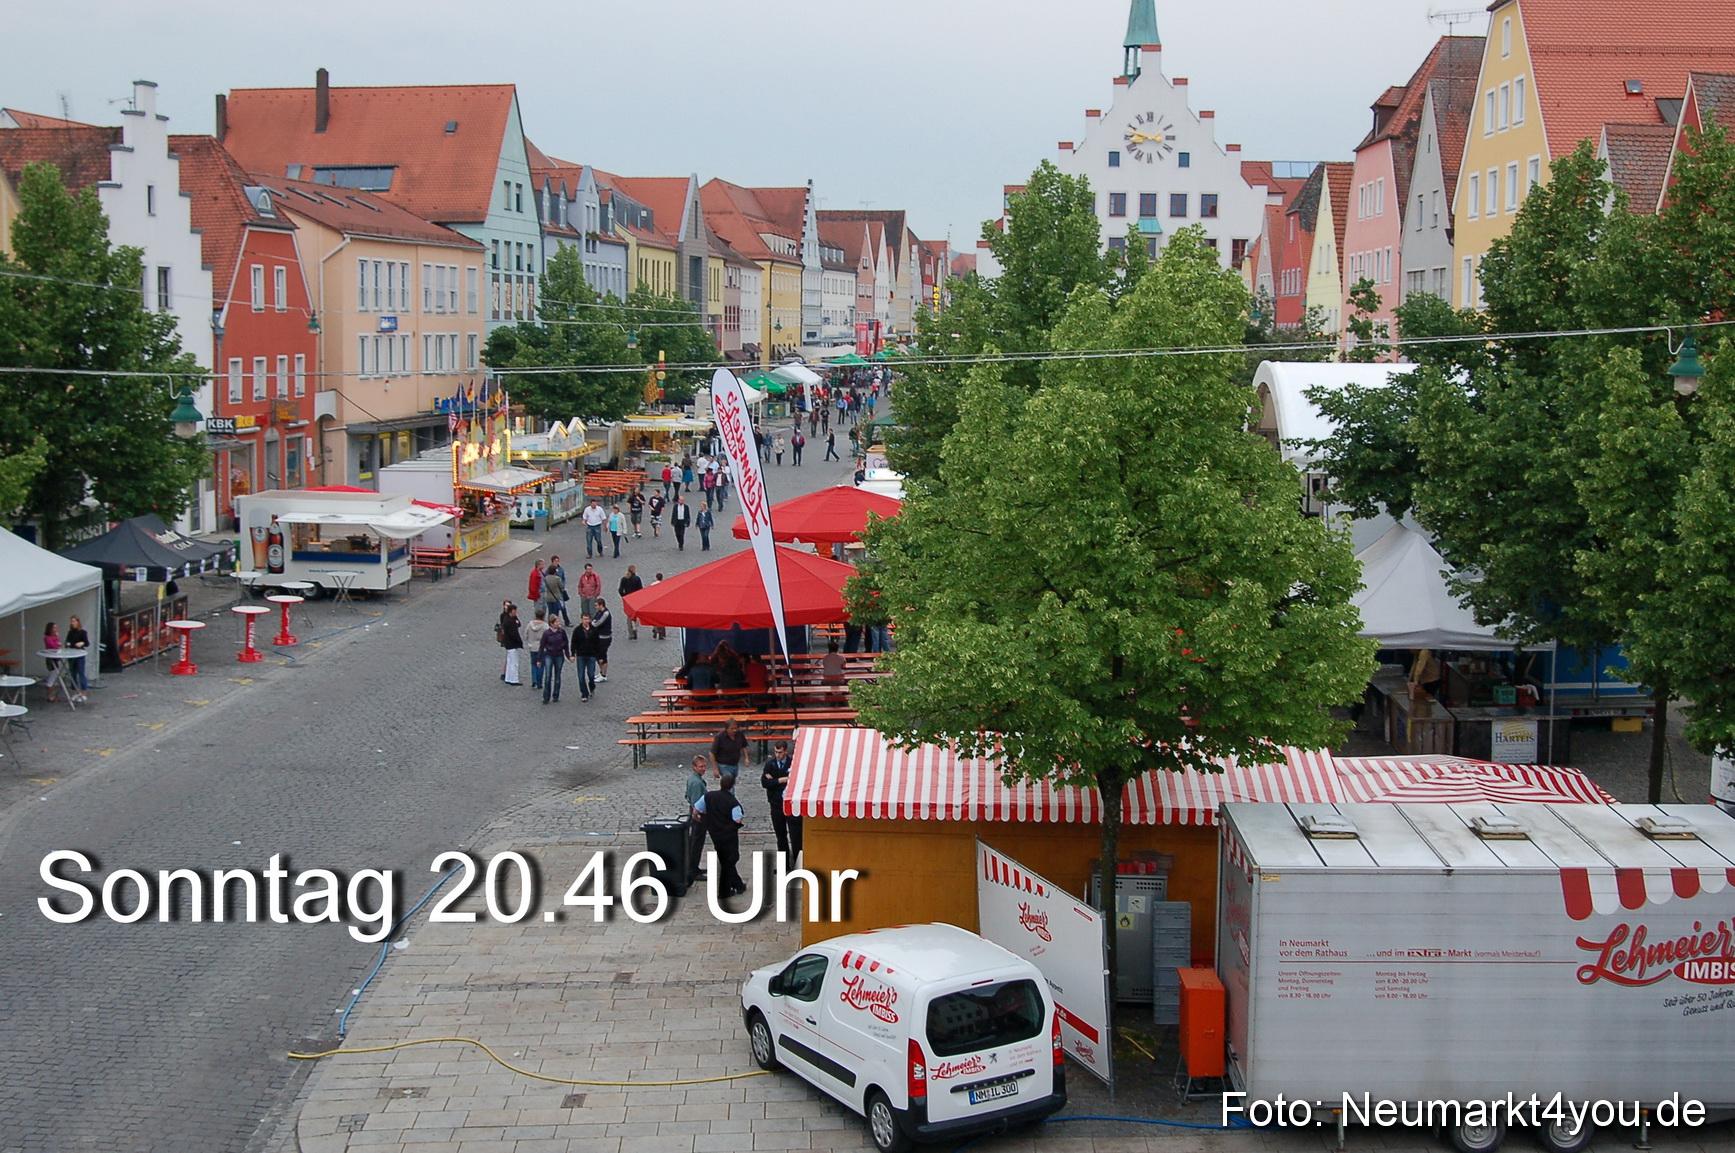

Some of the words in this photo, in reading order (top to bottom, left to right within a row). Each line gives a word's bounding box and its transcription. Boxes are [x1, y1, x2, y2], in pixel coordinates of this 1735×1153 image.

[207, 418, 234, 429] KBK
[1288, 939, 1329, 947] Neumarkt
[1294, 949, 1312, 957] dem
[1315, 949, 1348, 957] Rathaus
[1394, 949, 1404, 957] im
[1697, 992, 1708, 1003] 50
[1708, 988, 1734, 1005] Jahren
[1710, 1001, 1724, 1012] und
[872, 1004, 896, 1021] IMBISS
[975, 1092, 987, 1101] NM
[991, 1088, 1000, 1097] IL
[1002, 1083, 1016, 1095] 300
